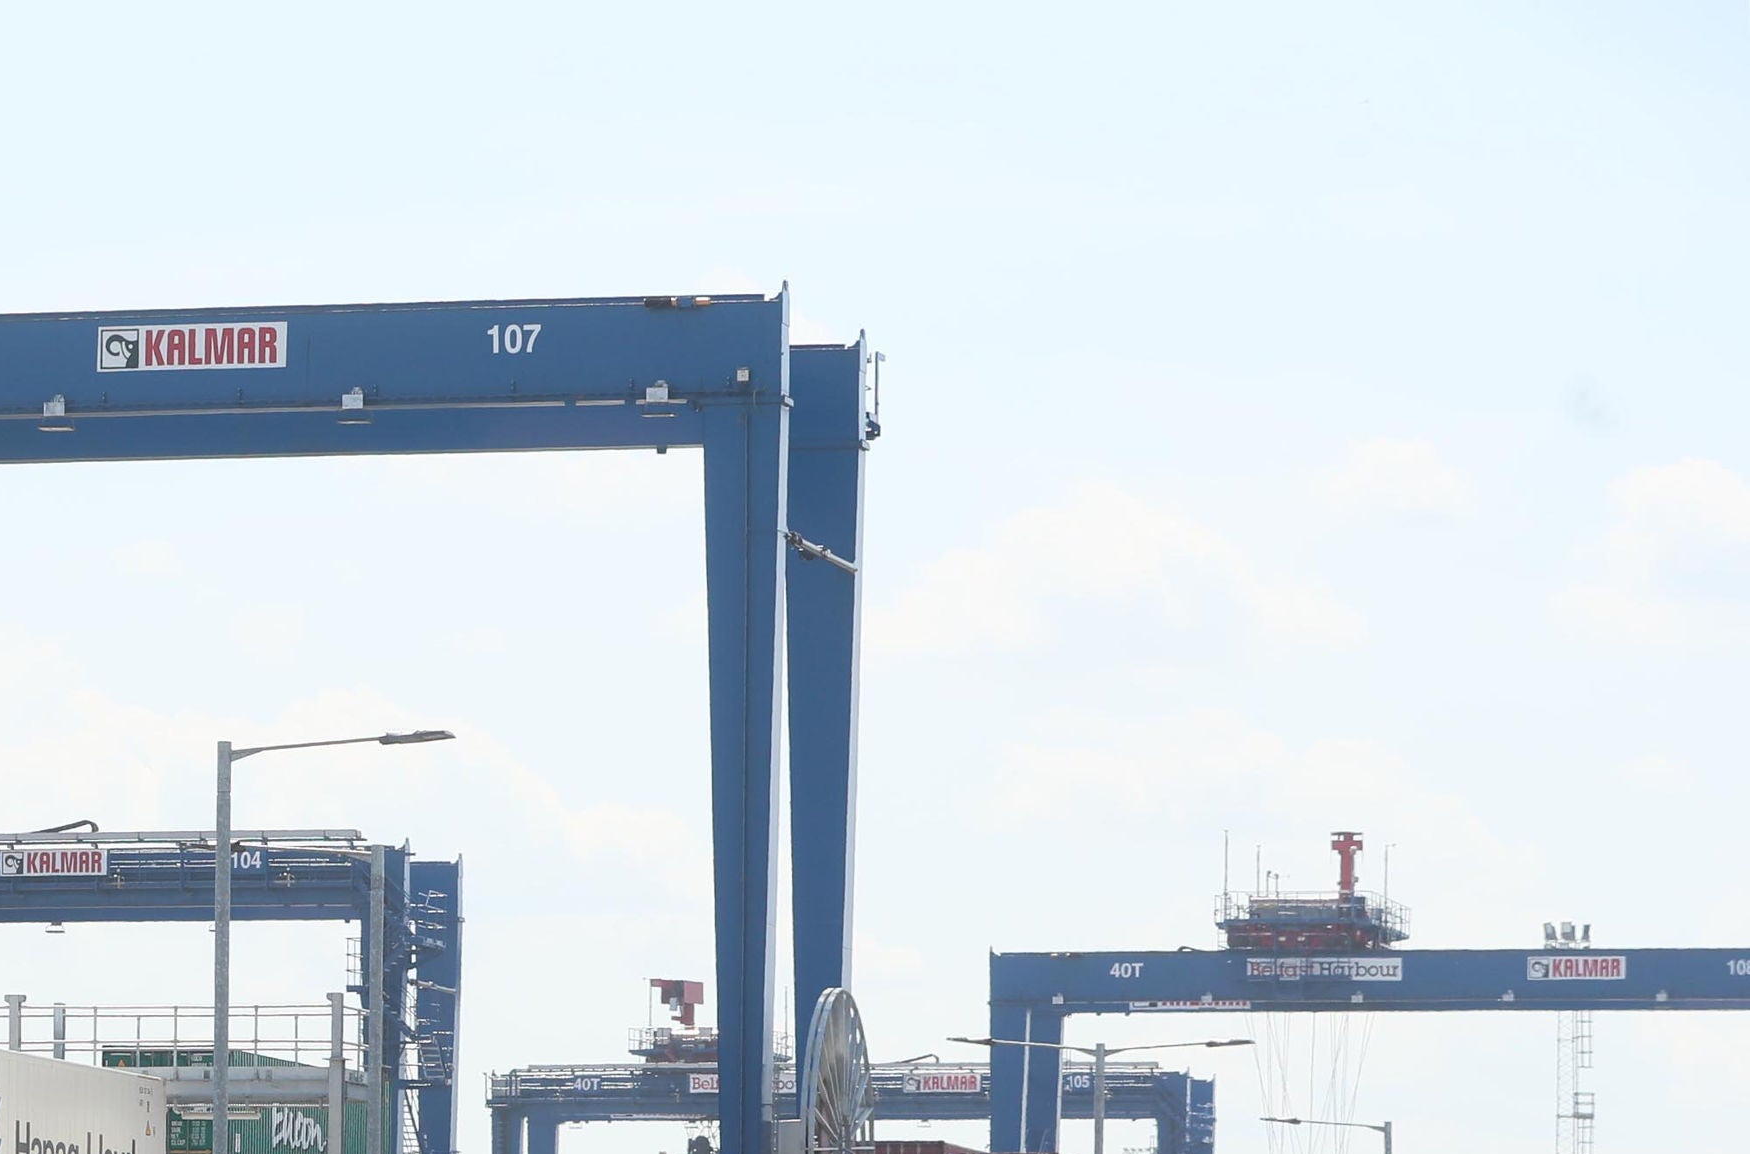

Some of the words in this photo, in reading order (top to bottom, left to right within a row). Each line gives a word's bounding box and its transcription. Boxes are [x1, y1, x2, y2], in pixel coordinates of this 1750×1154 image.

[143, 326, 278, 367] KALMAR
[487, 324, 542, 356] 107
[25, 850, 103, 874] KALMAR
[231, 851, 262, 869] 104
[1109, 963, 1144, 979] 40T
[1319, 961, 1400, 977] Harbour
[1551, 958, 1621, 978] KALMAR
[573, 1077, 602, 1092] 40T
[921, 1075, 978, 1091] KALMAR
